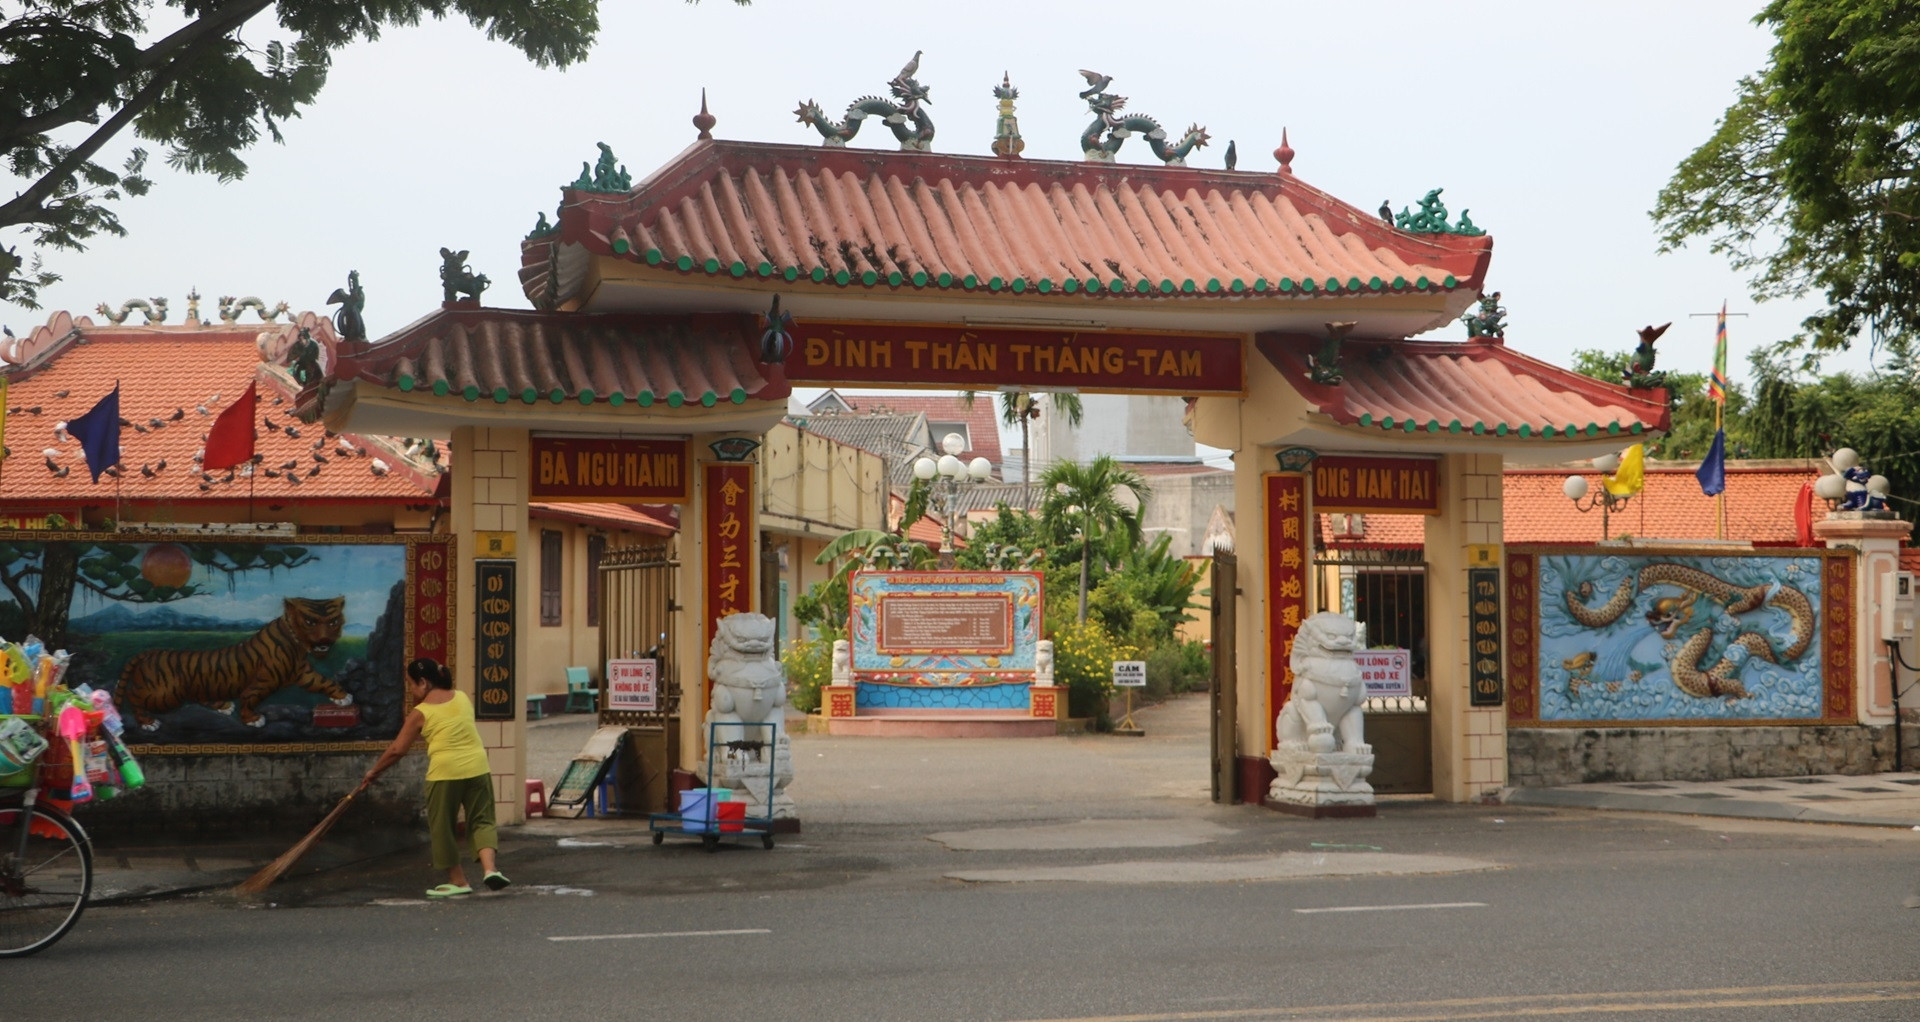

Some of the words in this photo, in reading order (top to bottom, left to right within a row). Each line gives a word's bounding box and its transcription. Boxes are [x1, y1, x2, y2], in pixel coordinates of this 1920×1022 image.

[804, 330, 892, 368] ĐÌNH
[905, 332, 998, 372] THẦN
[1009, 332, 1202, 378] THẮNG-TAM
[540, 441, 570, 485] BÀ
[1389, 671, 1399, 680] XE
